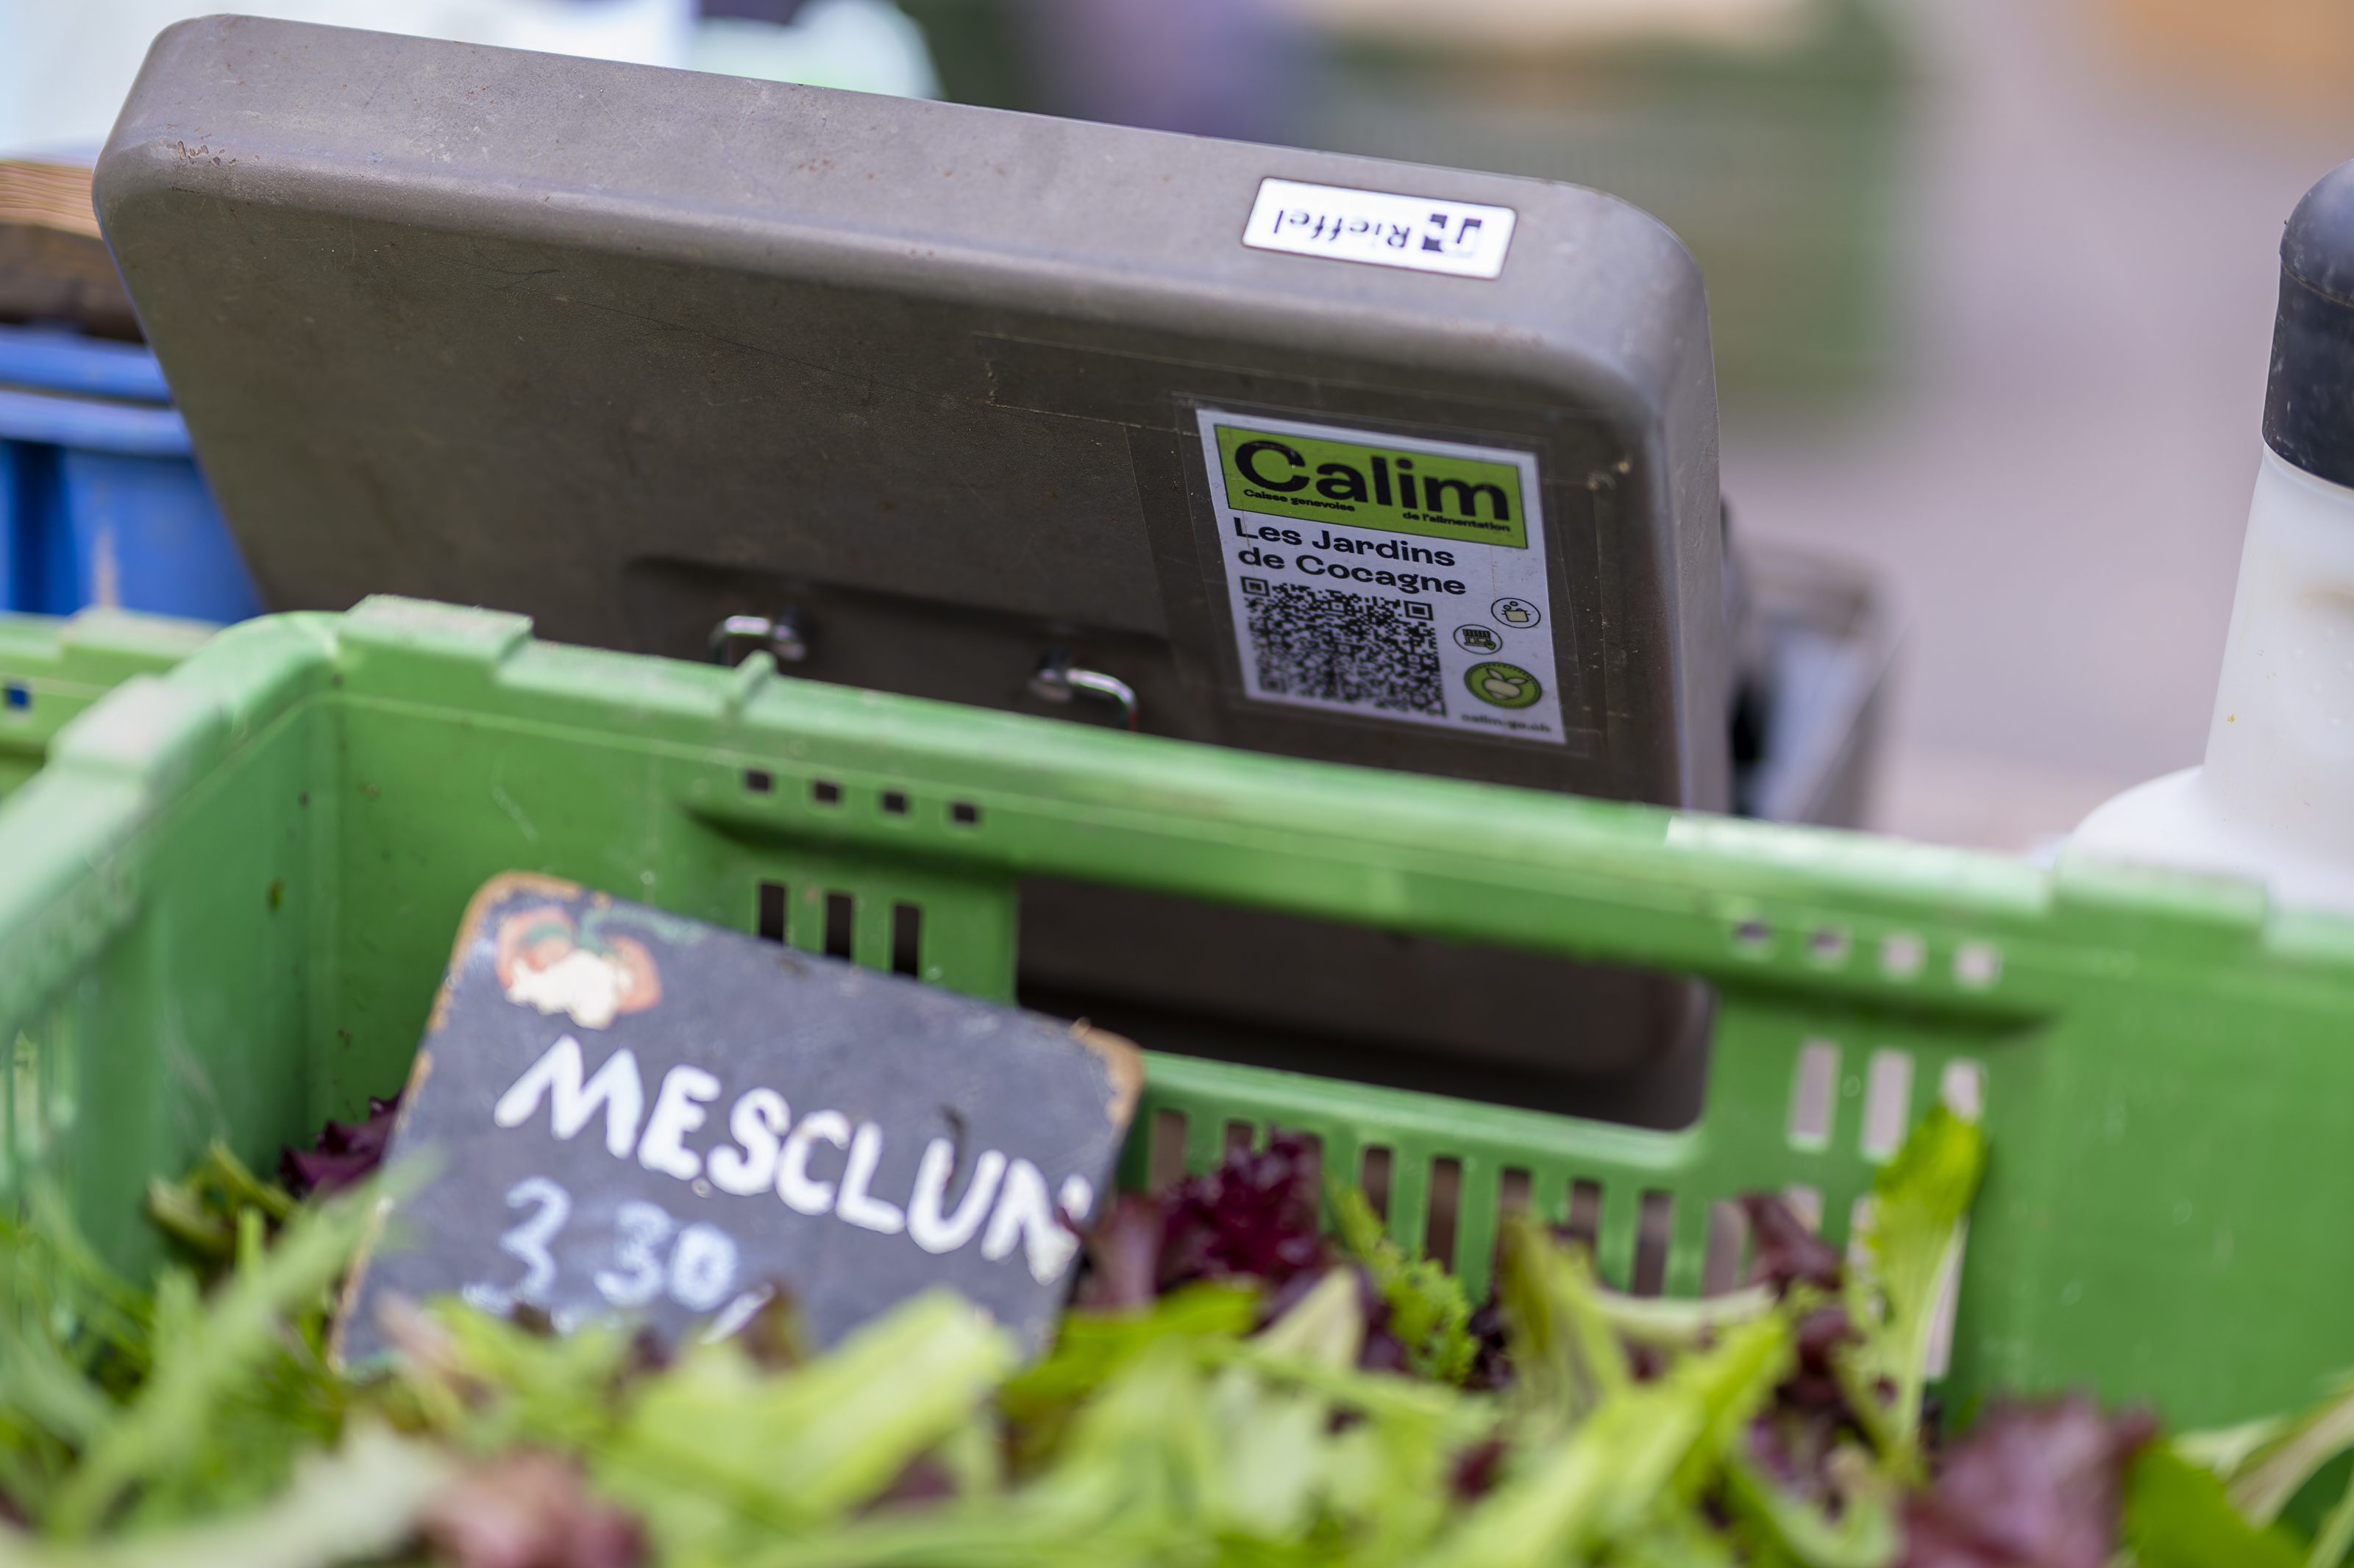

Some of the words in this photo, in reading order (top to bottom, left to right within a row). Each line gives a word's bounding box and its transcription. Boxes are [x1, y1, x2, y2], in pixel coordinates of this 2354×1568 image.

[1273, 210, 1410, 249] Rieffel
[1234, 440, 1510, 521] Calim
[1243, 488, 1287, 502] Caisse
[1290, 496, 1355, 512] genevoise
[1402, 511, 1420, 521] de
[1422, 513, 1510, 532] l'alimentation
[1233, 517, 1302, 546] Les
[1312, 530, 1455, 567] Jardins
[1237, 547, 1285, 569] de
[1295, 555, 1466, 595] Cocagne
[494, 1035, 1093, 1285] MESCLUN
